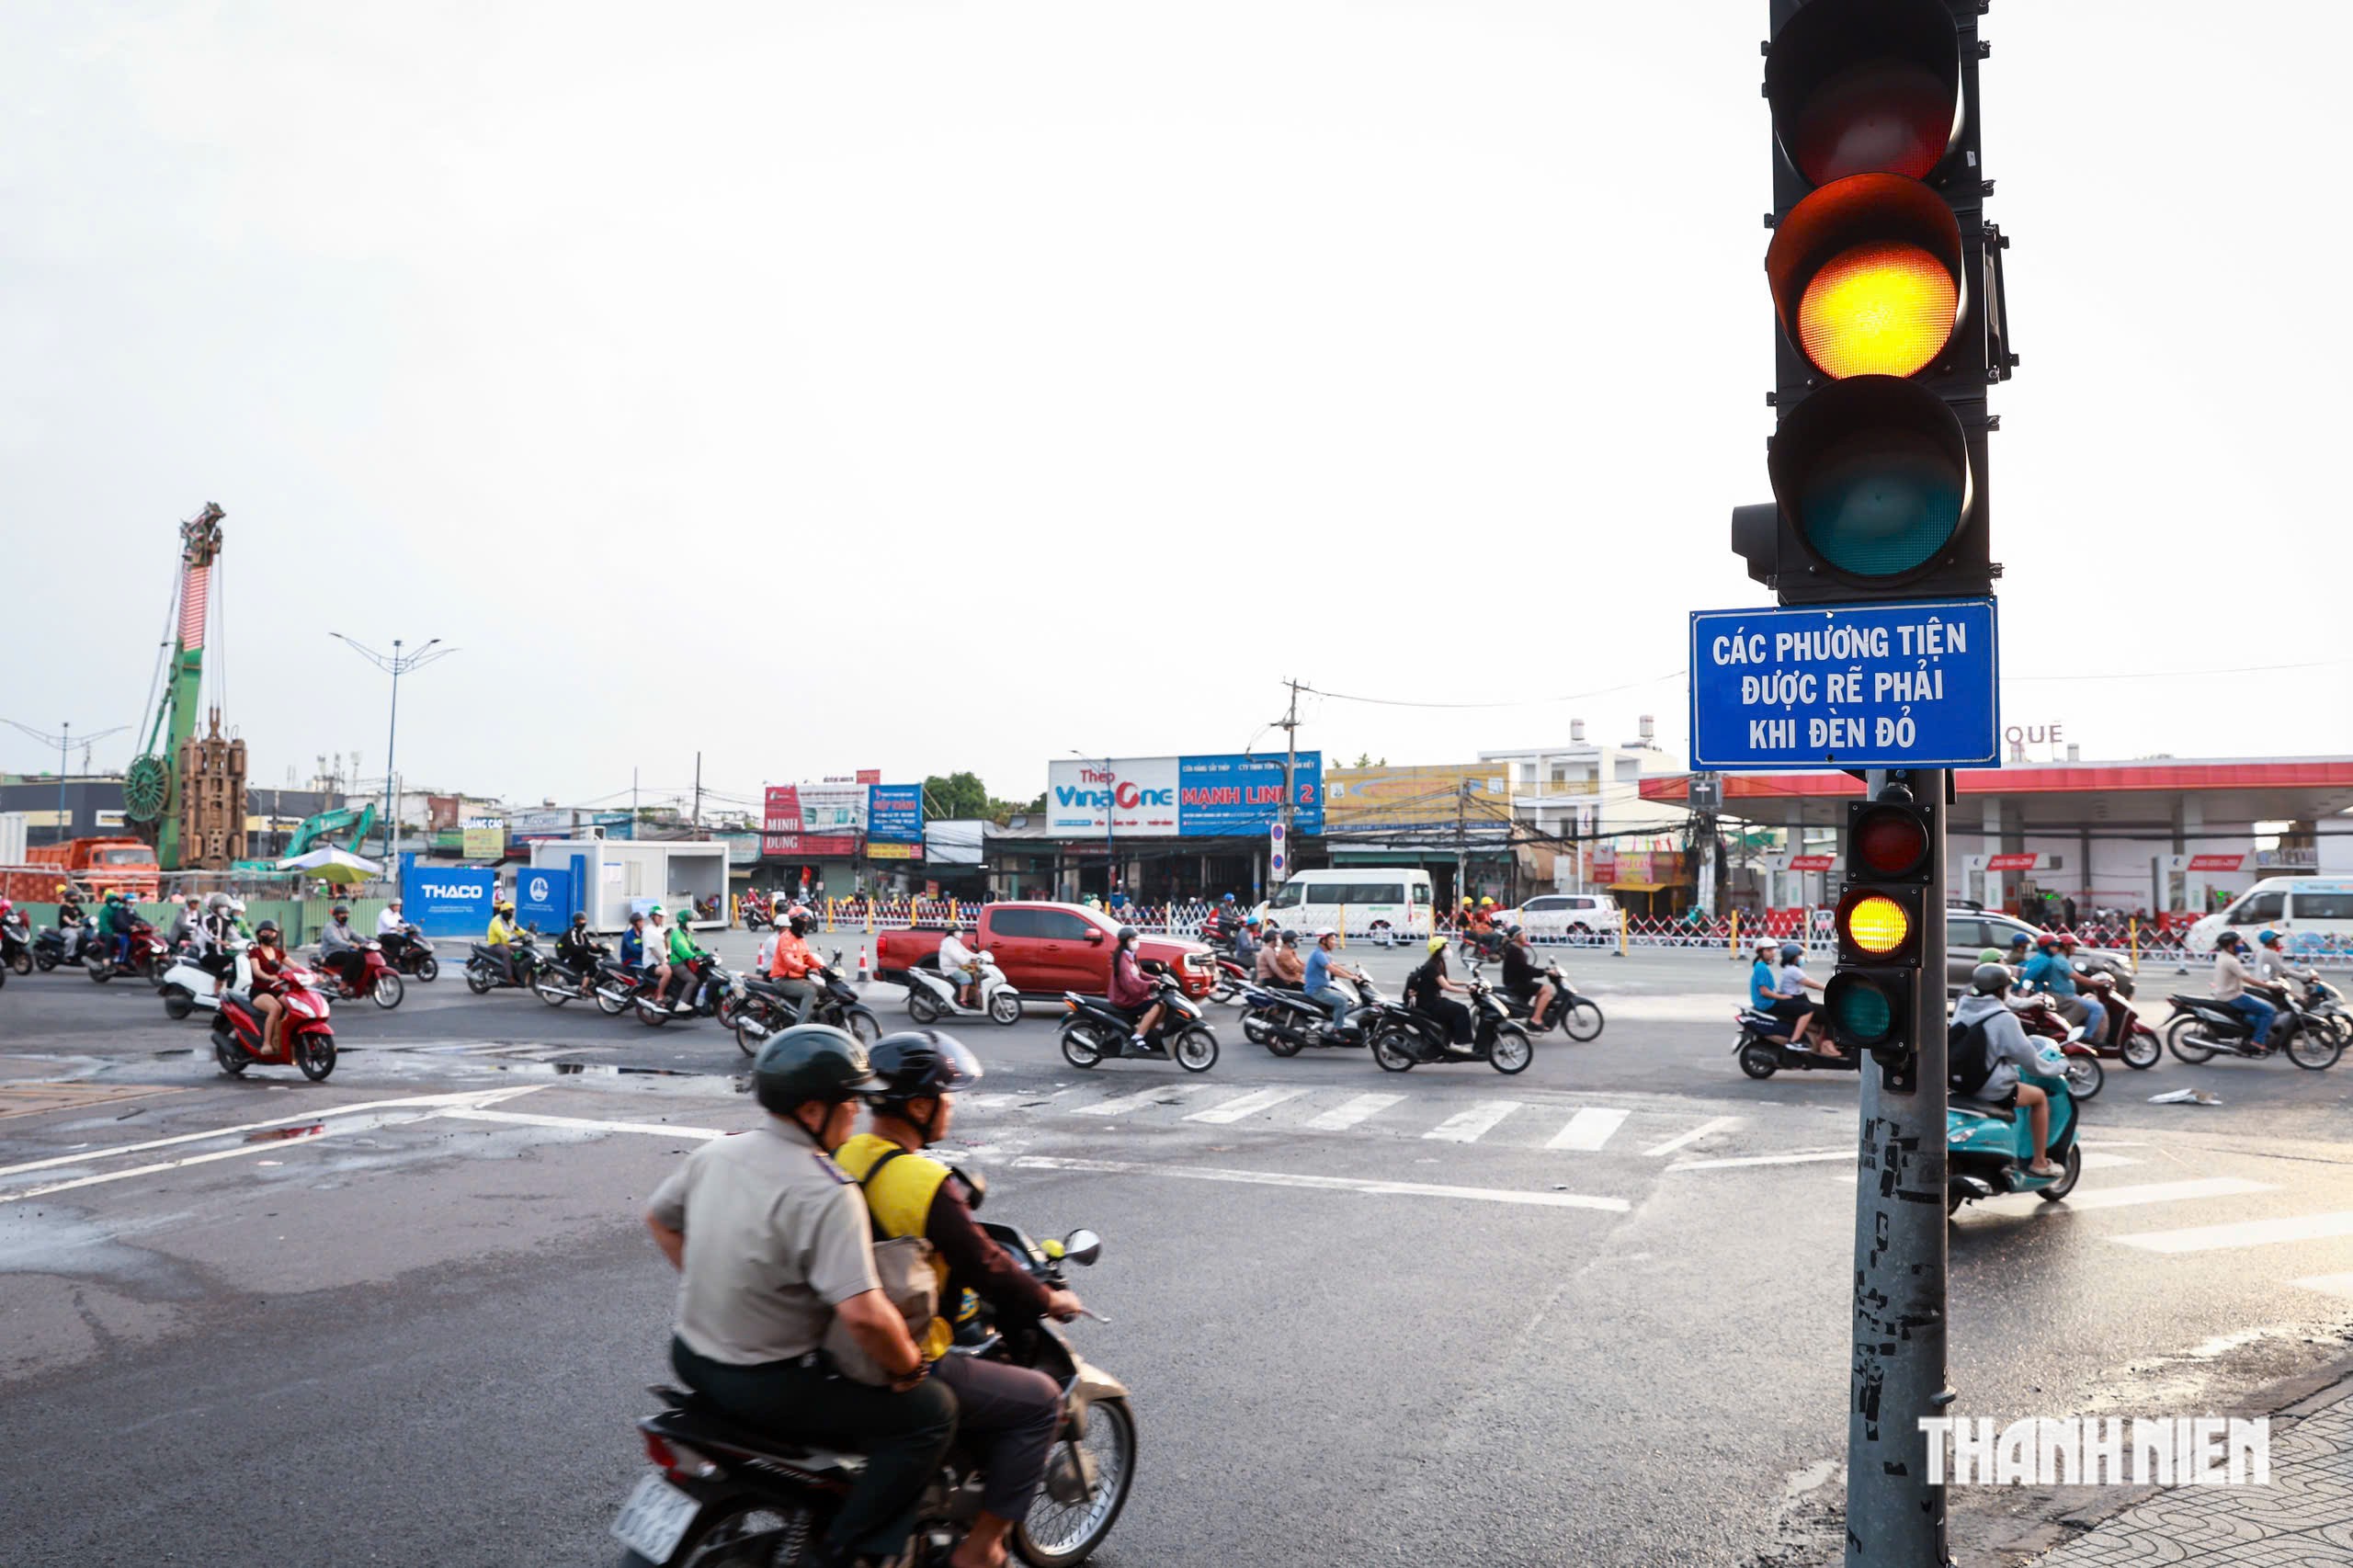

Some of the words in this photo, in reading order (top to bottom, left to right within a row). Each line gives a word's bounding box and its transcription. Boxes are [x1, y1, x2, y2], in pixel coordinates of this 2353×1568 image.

[1712, 626, 1767, 665] CÁC
[1775, 625, 1890, 663] PHƯƠNG
[1897, 617, 1966, 663] TIỆN
[1741, 669, 1817, 711] ĐƯỢC
[1826, 665, 1863, 703] RẼ
[1874, 659, 1943, 703] PHẢI
[1749, 719, 1796, 749] KHI
[1808, 707, 1866, 749] ĐÈN
[1875, 705, 1916, 748] ĐỎ
[1080, 767, 1116, 786] Thép
[1181, 787, 1240, 810] MẠNH
[1300, 783, 1314, 803] 2
[767, 818, 798, 832] MINH
[421, 884, 483, 899] THACO
